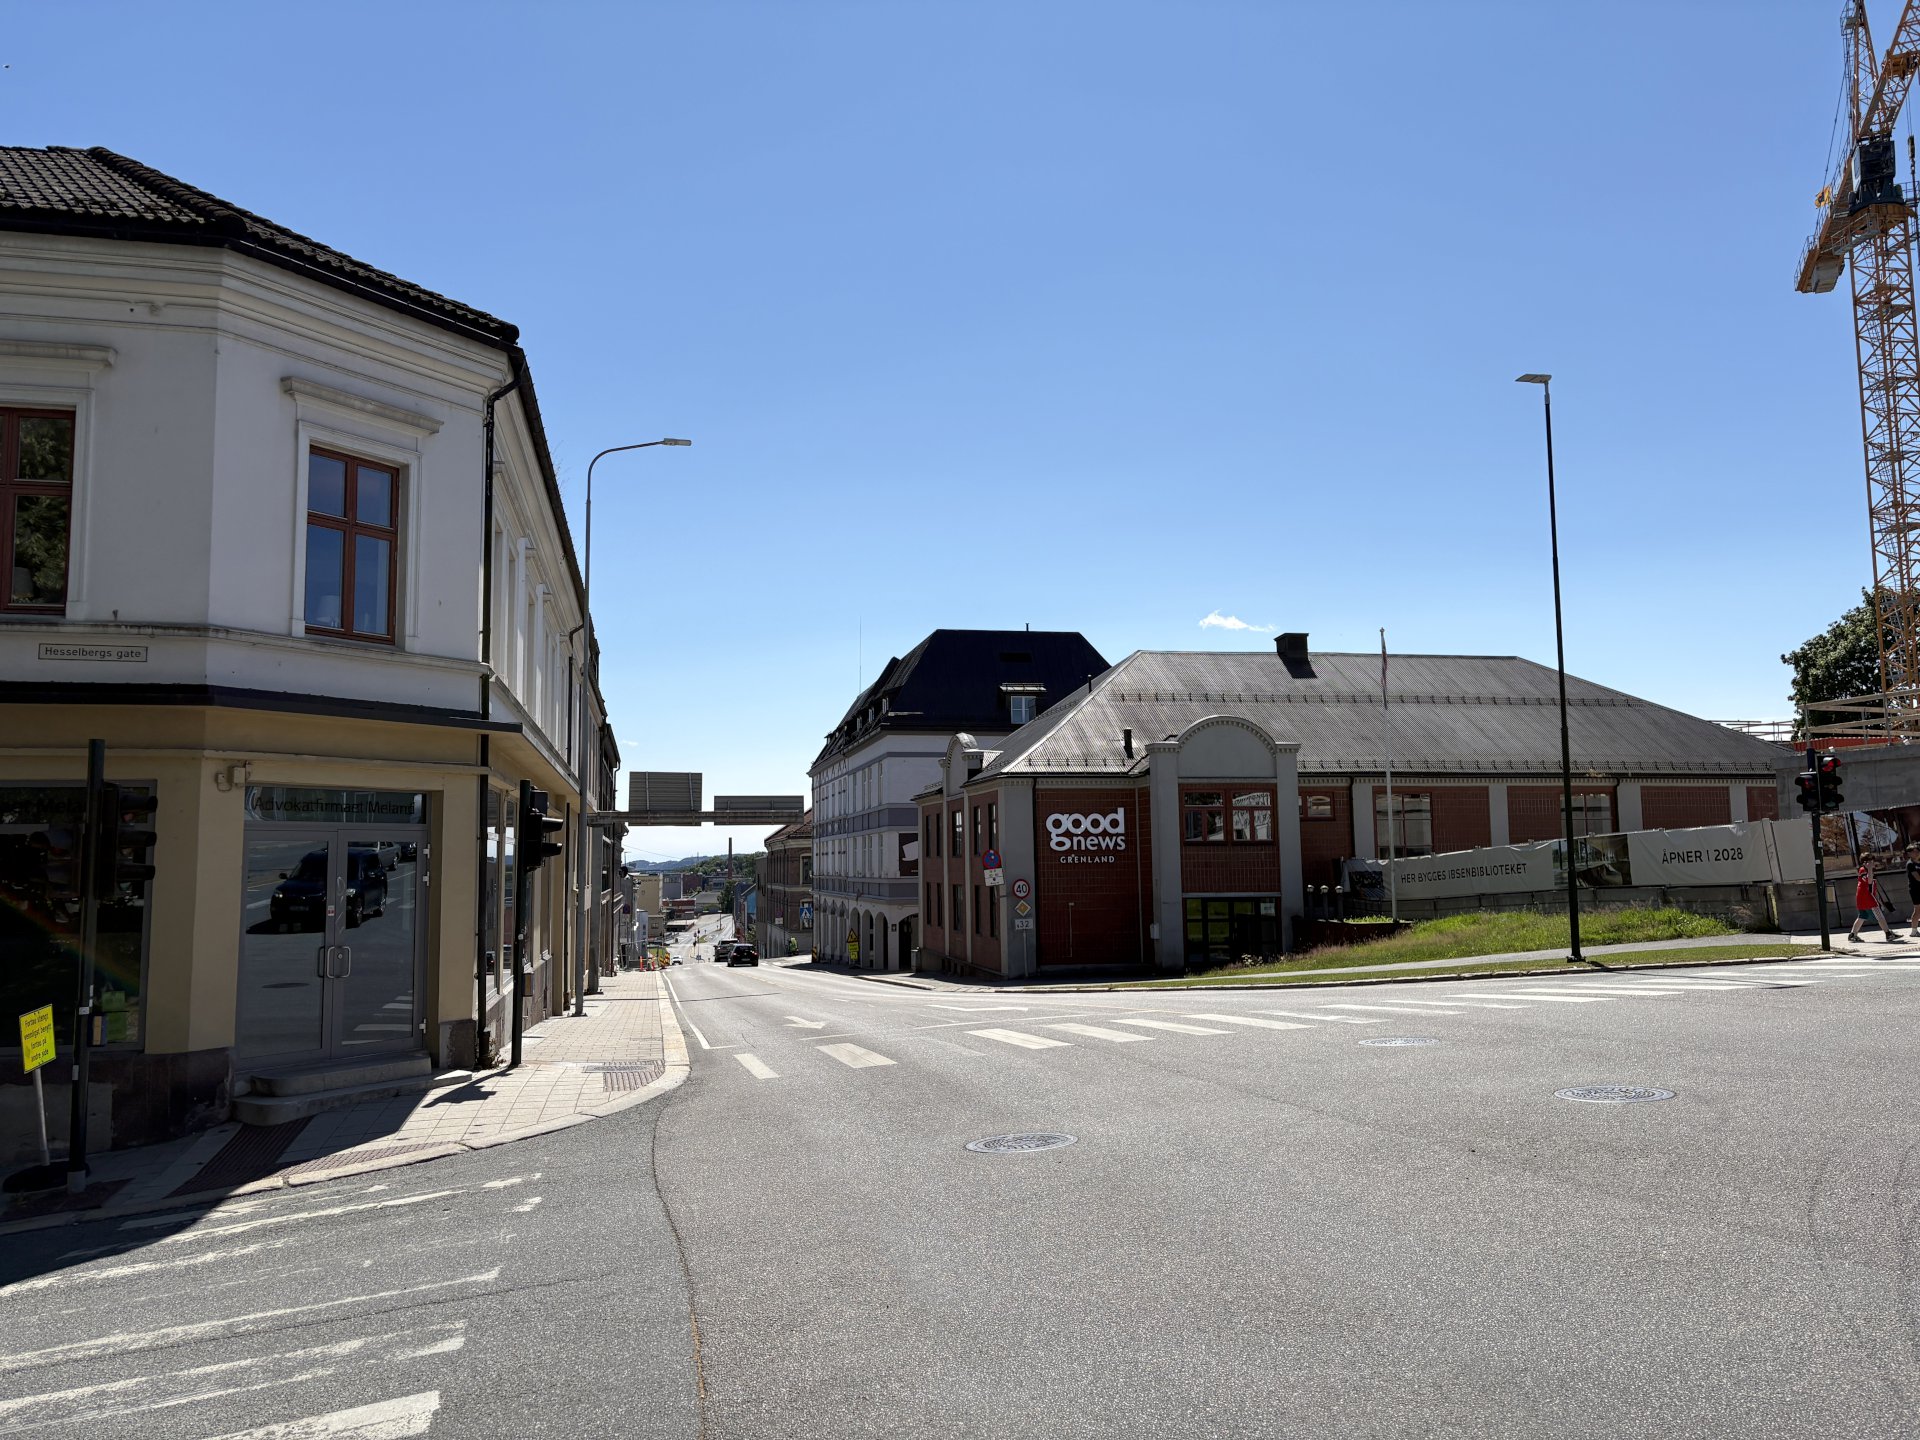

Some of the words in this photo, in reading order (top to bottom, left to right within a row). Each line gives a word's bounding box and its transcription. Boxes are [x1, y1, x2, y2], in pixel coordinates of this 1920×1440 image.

[45, 647, 112, 659] Hesselbergs
[116, 650, 141, 659] gate
[255, 797, 363, 813] Advokatfirmaet
[368, 801, 415, 815] Meland
[1046, 807, 1125, 851] good
[1662, 848, 1703, 864] ÅPNER
[1713, 847, 1744, 862] 2028
[1401, 873, 1416, 883] HER
[1417, 870, 1446, 882] BYGGES
[1448, 863, 1527, 879] IBSENBIBLIOTEKET
[1016, 884, 1027, 894] 40
